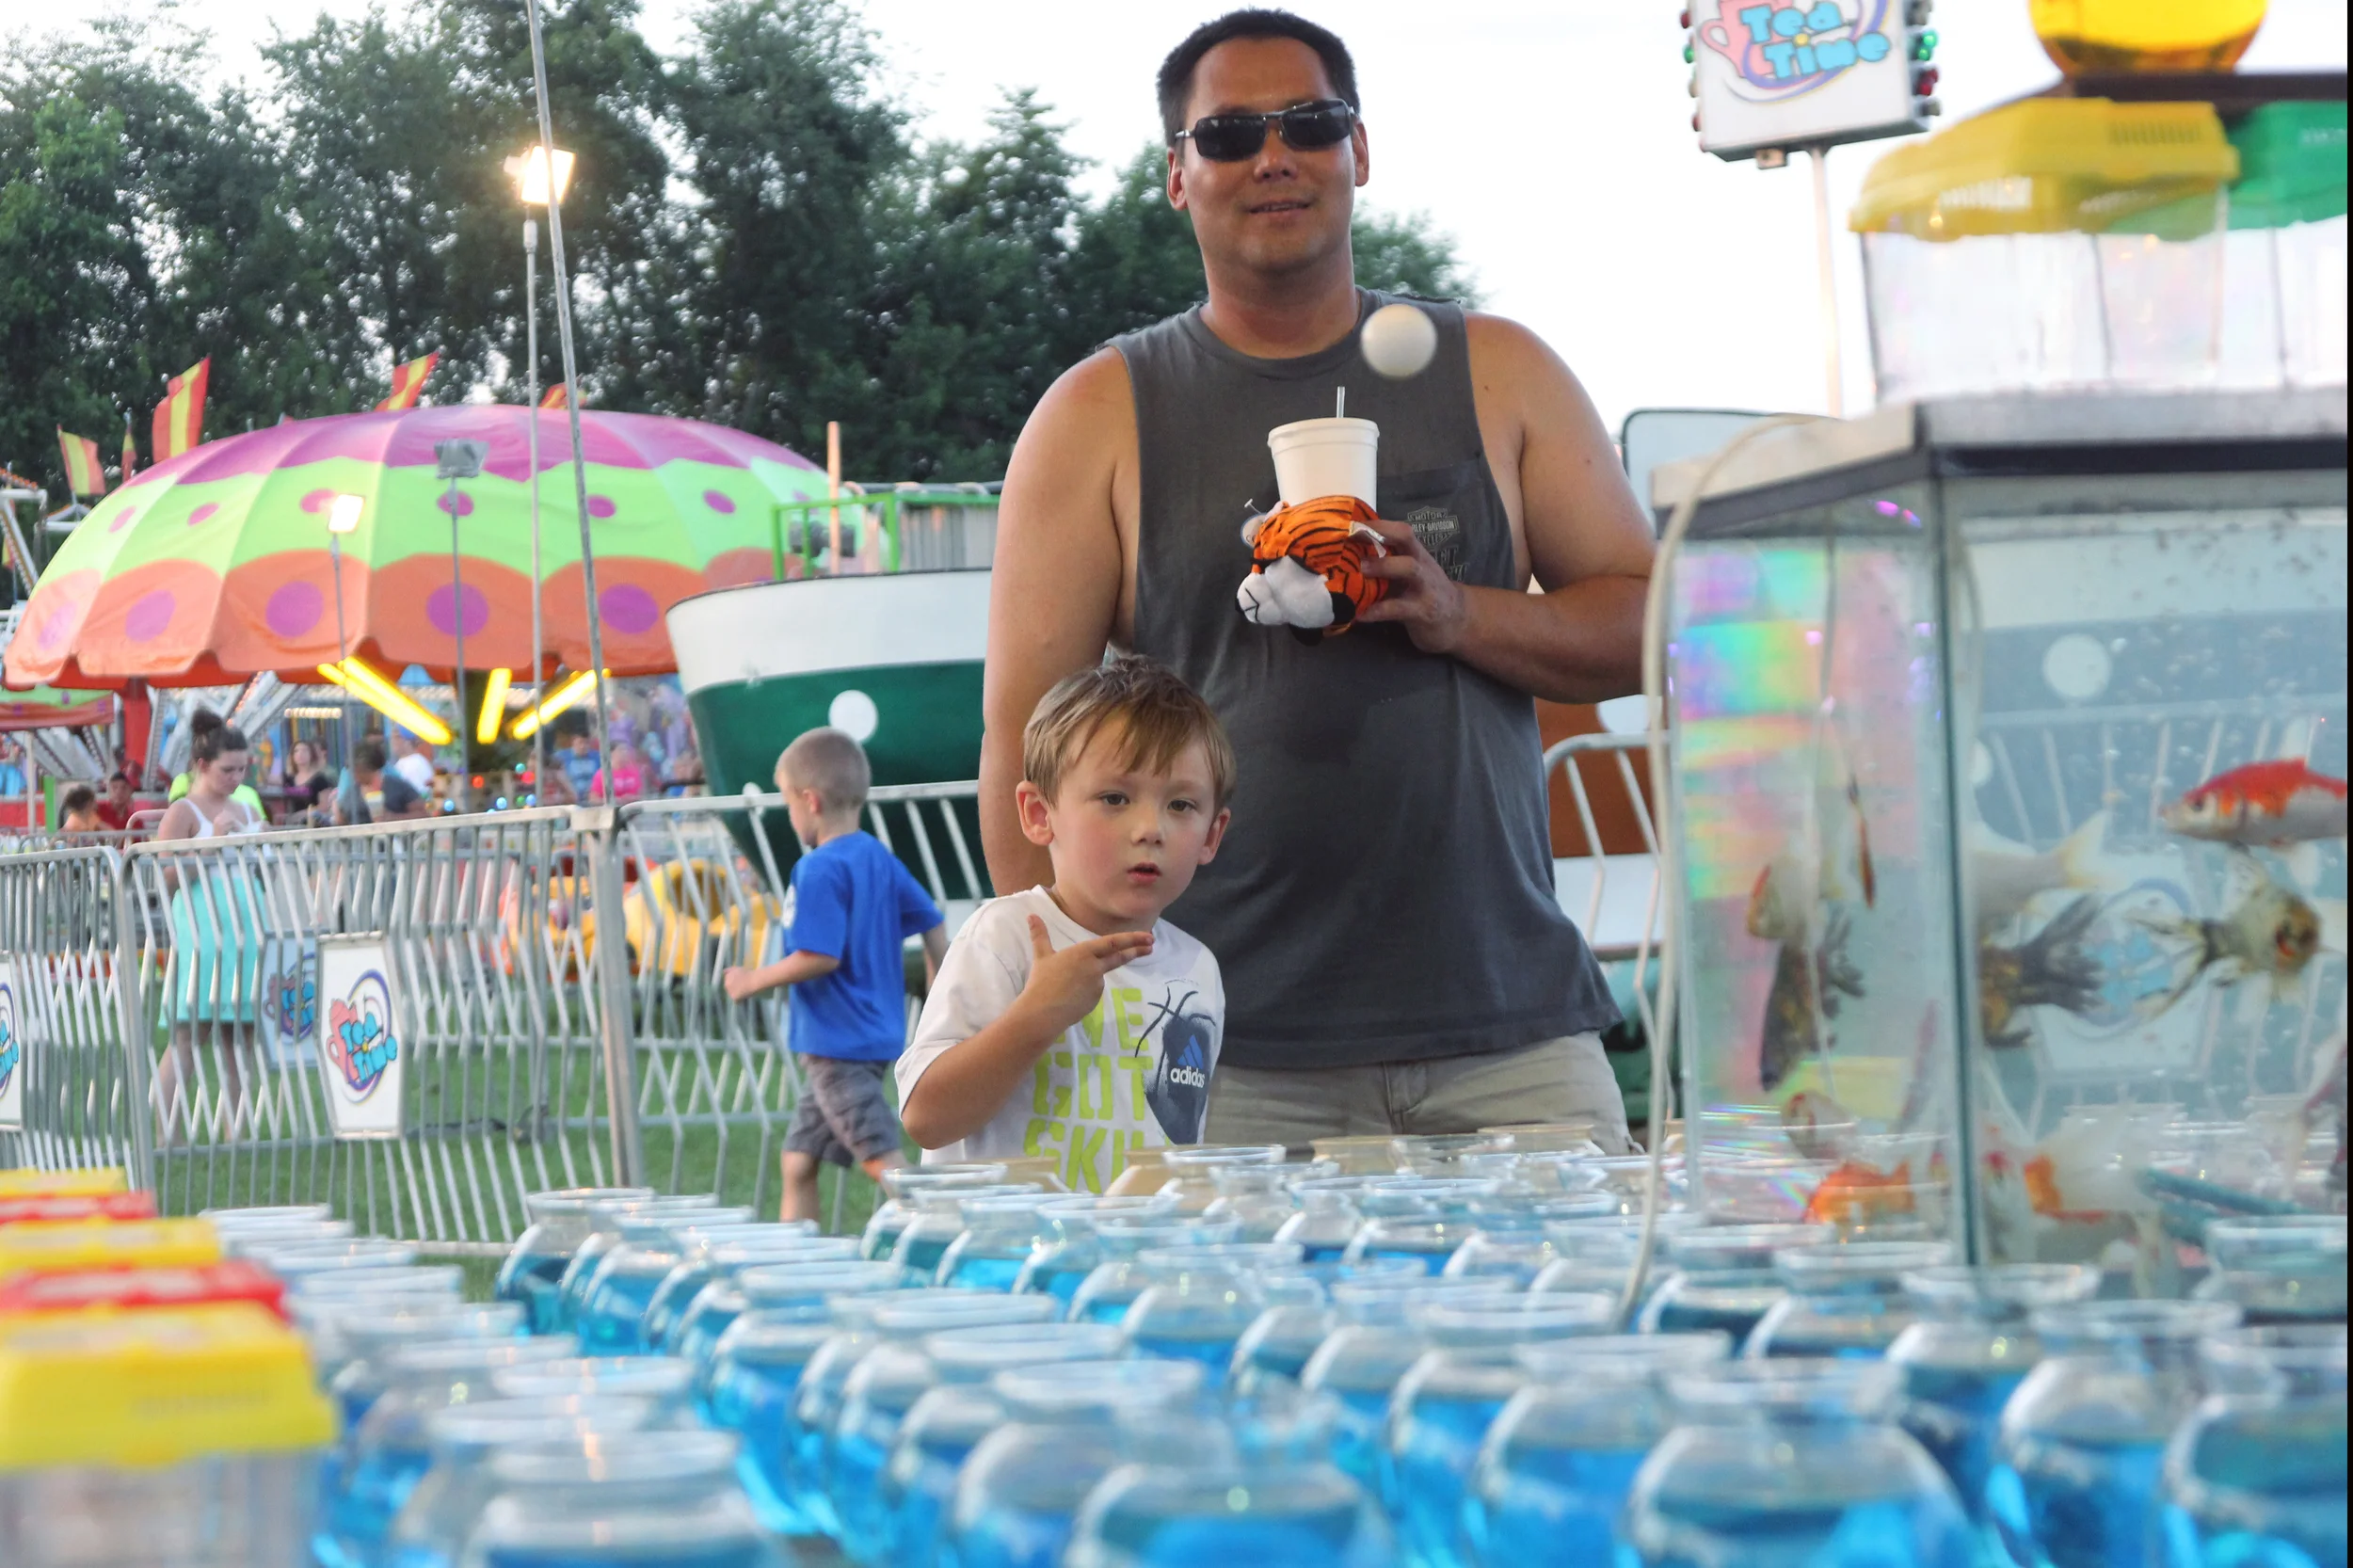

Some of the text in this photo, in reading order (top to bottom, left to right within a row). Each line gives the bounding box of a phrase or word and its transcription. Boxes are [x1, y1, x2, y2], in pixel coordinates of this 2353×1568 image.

[1739, 1, 1842, 43] Tea
[1762, 31, 1891, 79] Time
[1411, 520, 1455, 534] RLEY-DAVIDSON
[339, 1011, 377, 1053] Tea
[352, 1034, 398, 1081] Time
[1170, 1064, 1206, 1088] adidas
[1033, 1051, 1154, 1121] GOT
